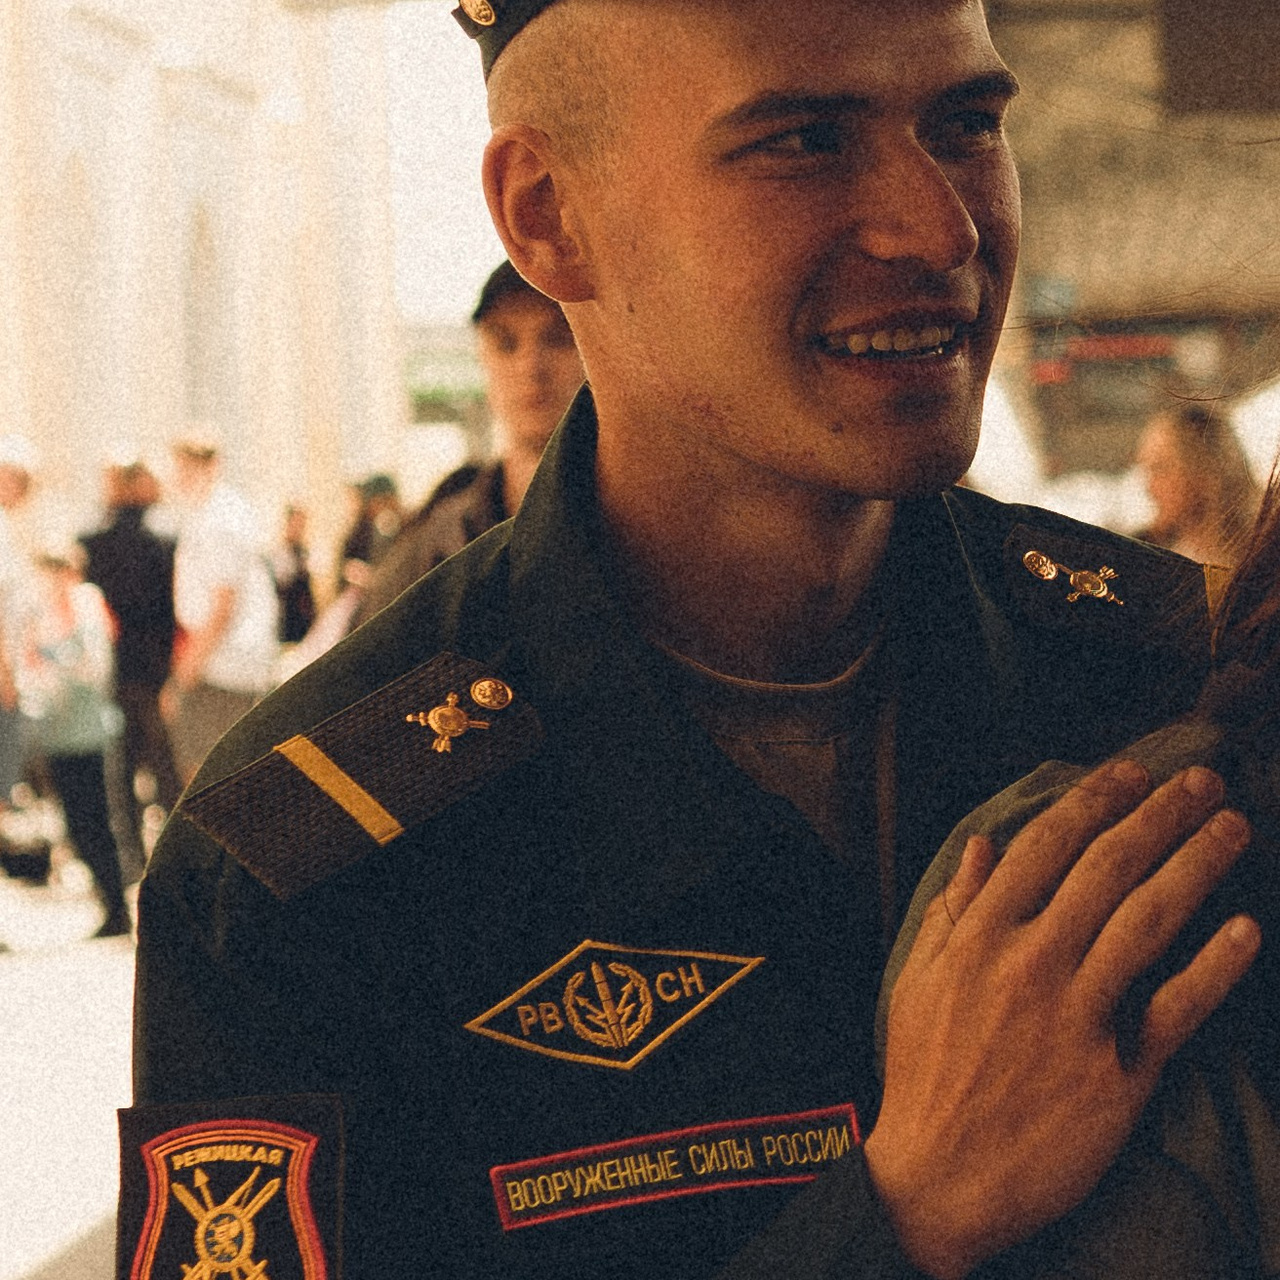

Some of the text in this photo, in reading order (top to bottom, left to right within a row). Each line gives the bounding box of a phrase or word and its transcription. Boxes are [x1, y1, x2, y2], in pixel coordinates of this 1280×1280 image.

[517, 962, 706, 1036] РВ СН
[506, 1124, 850, 1212] ВООРУЖЕННЫЕ СИЛЫ РОССИИ
